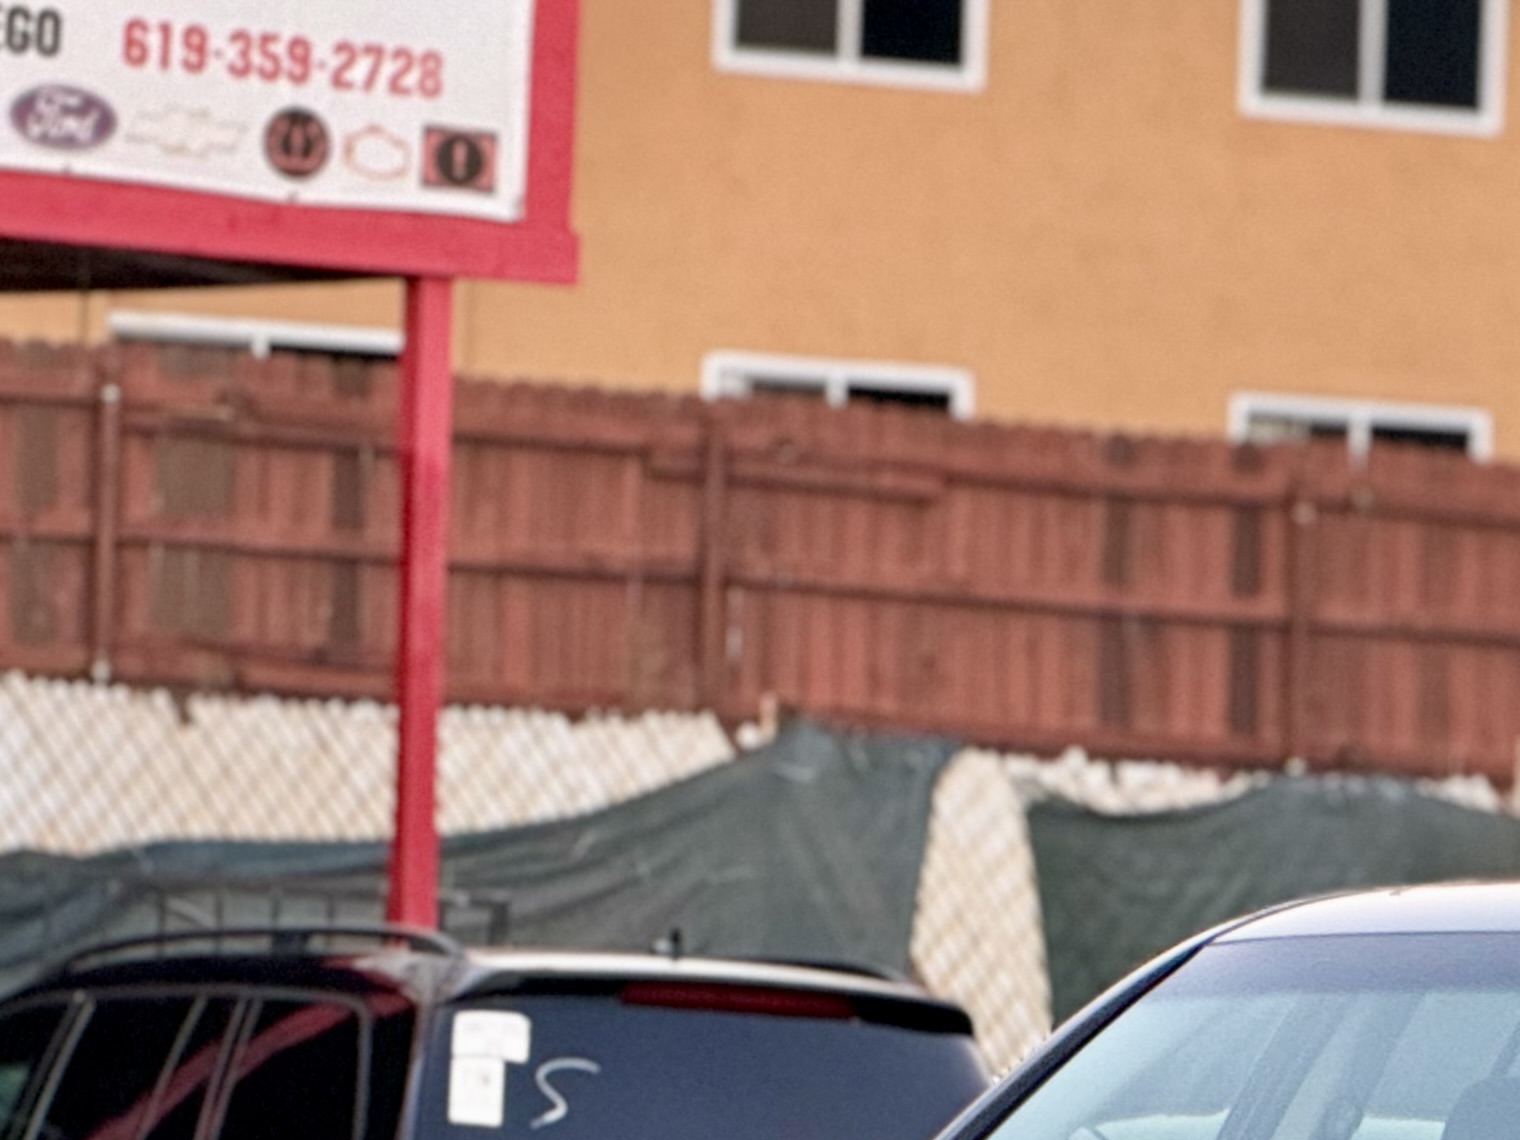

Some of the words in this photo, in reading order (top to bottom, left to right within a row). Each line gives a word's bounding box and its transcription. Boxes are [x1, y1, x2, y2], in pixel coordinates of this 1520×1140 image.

[0, 4, 62, 57] GO
[121, 17, 445, 98] 619-359-2728
[26, 92, 104, 142] Ford
